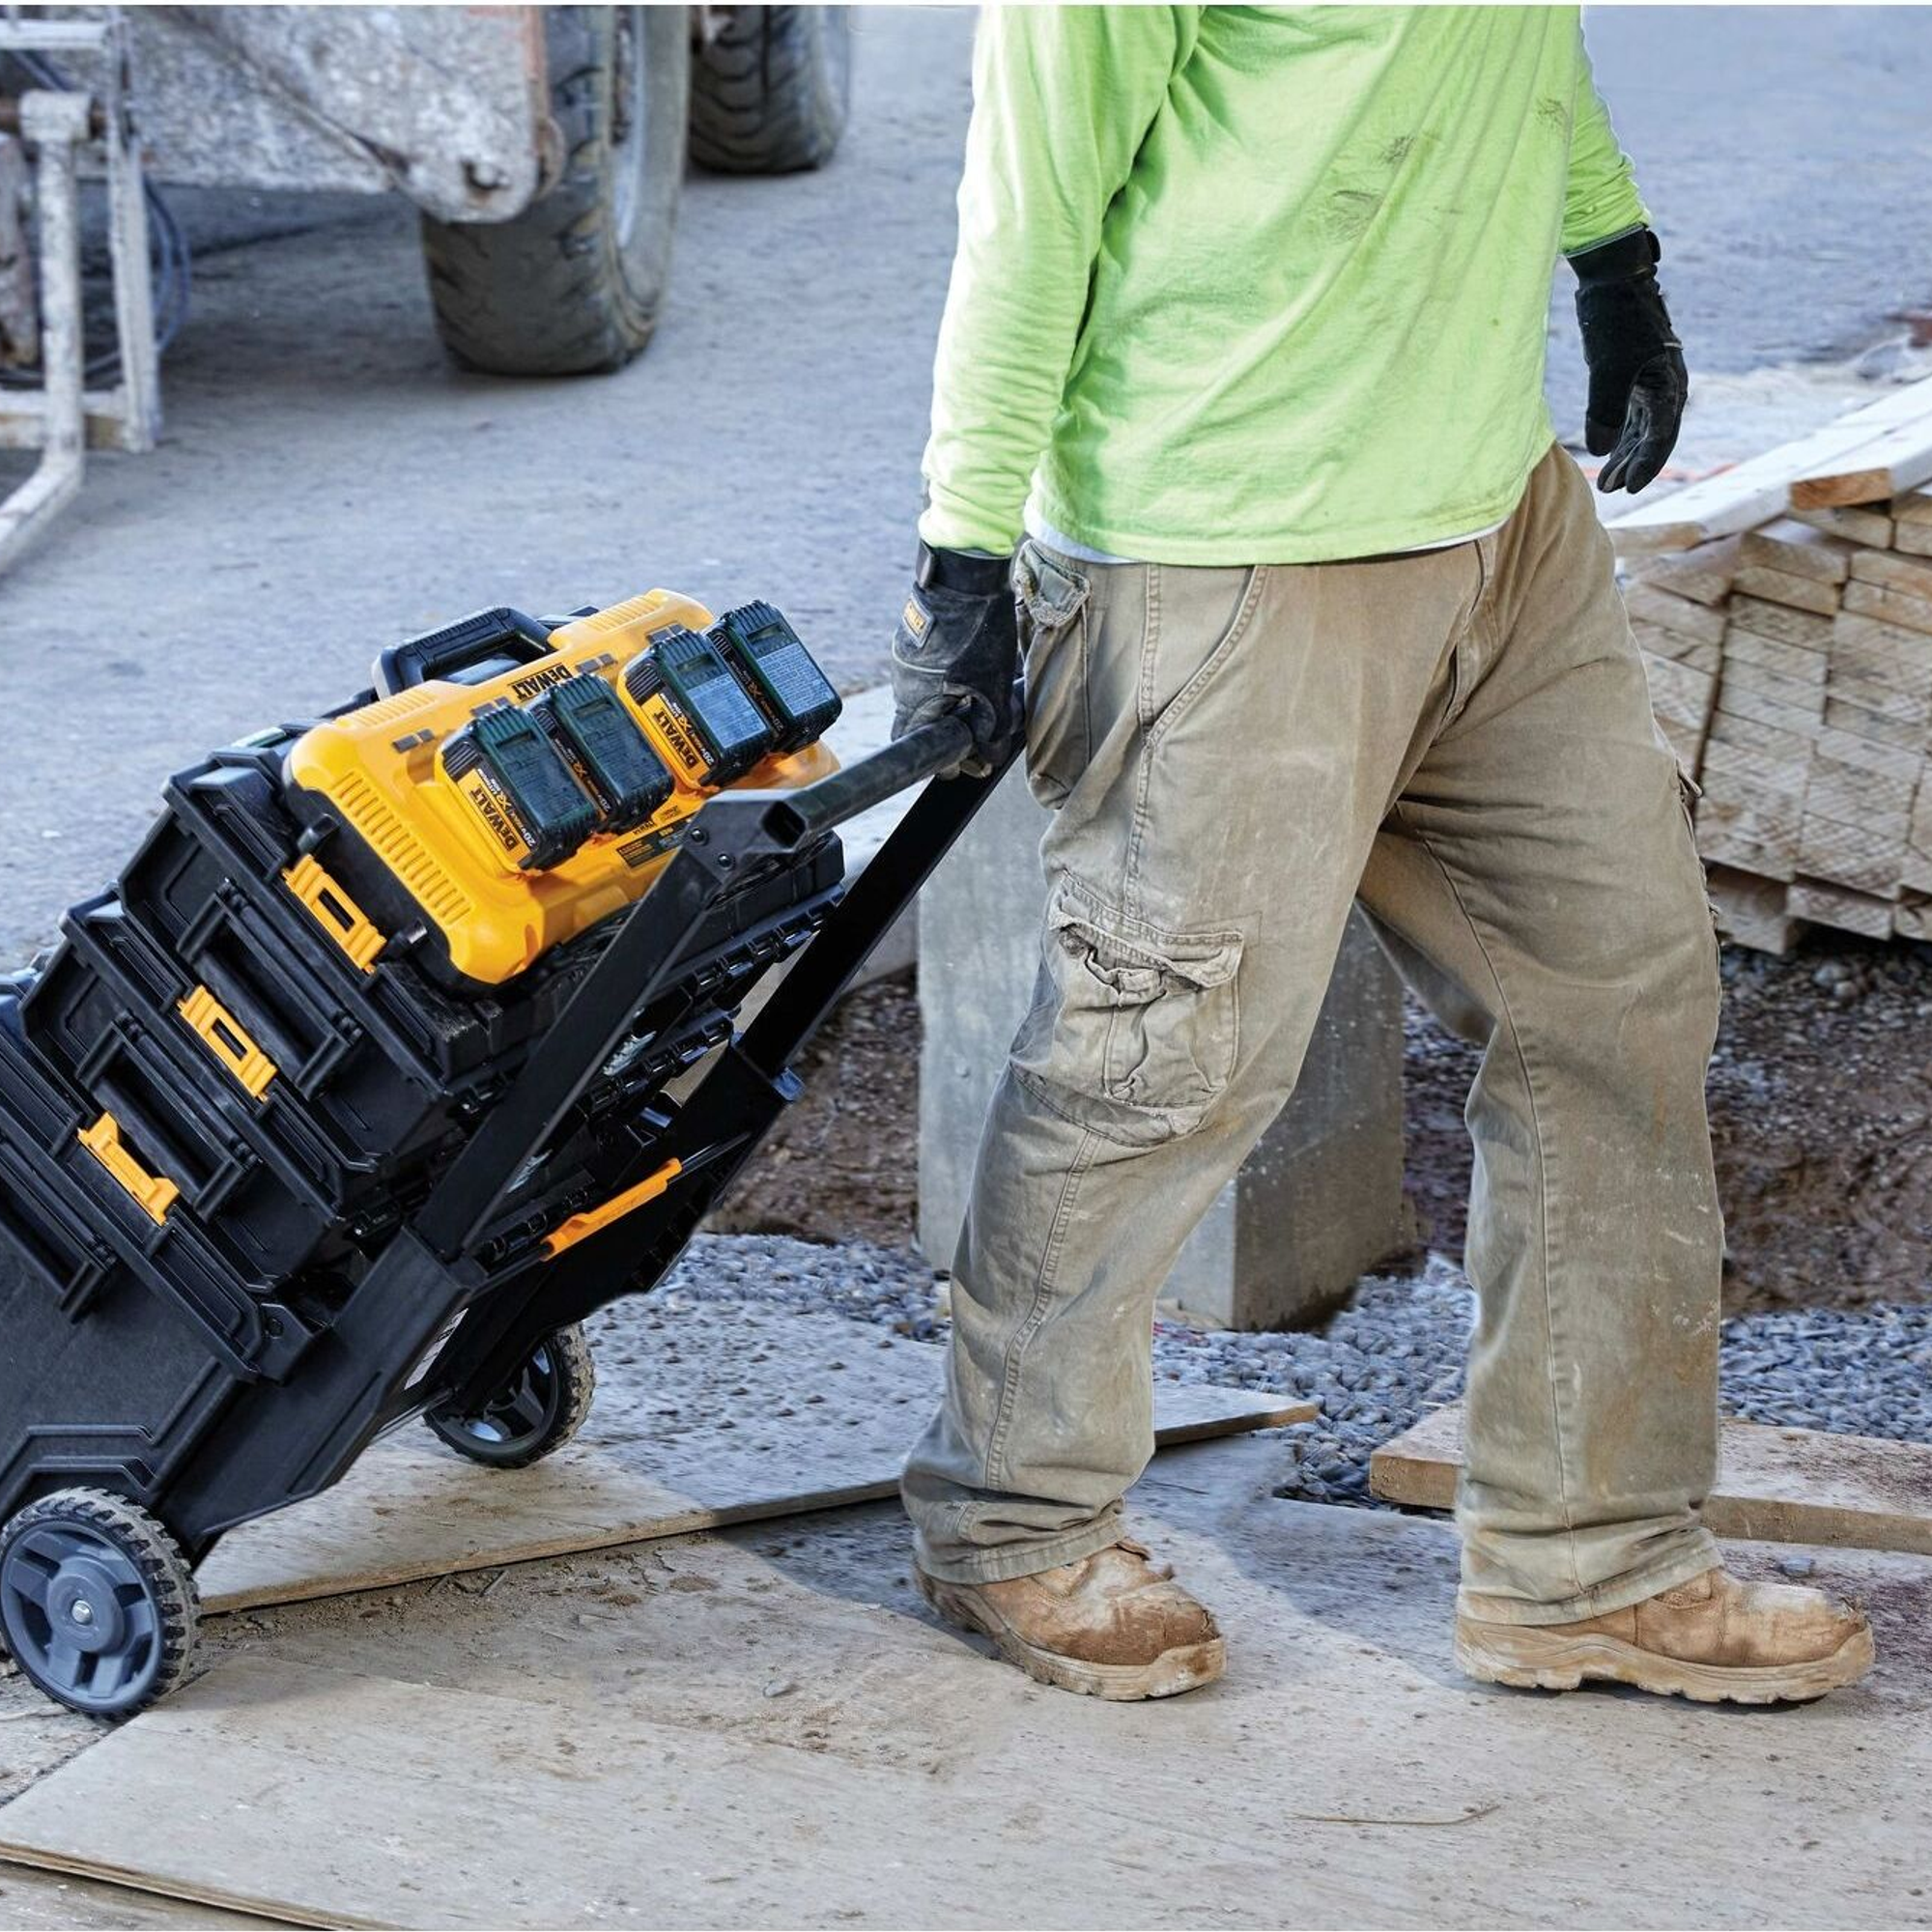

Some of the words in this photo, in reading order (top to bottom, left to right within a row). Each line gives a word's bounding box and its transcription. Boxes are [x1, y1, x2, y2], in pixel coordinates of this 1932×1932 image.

[510, 664, 573, 701] DEWALT
[652, 709, 698, 769] DEWALT
[469, 785, 519, 851] DEWALT
